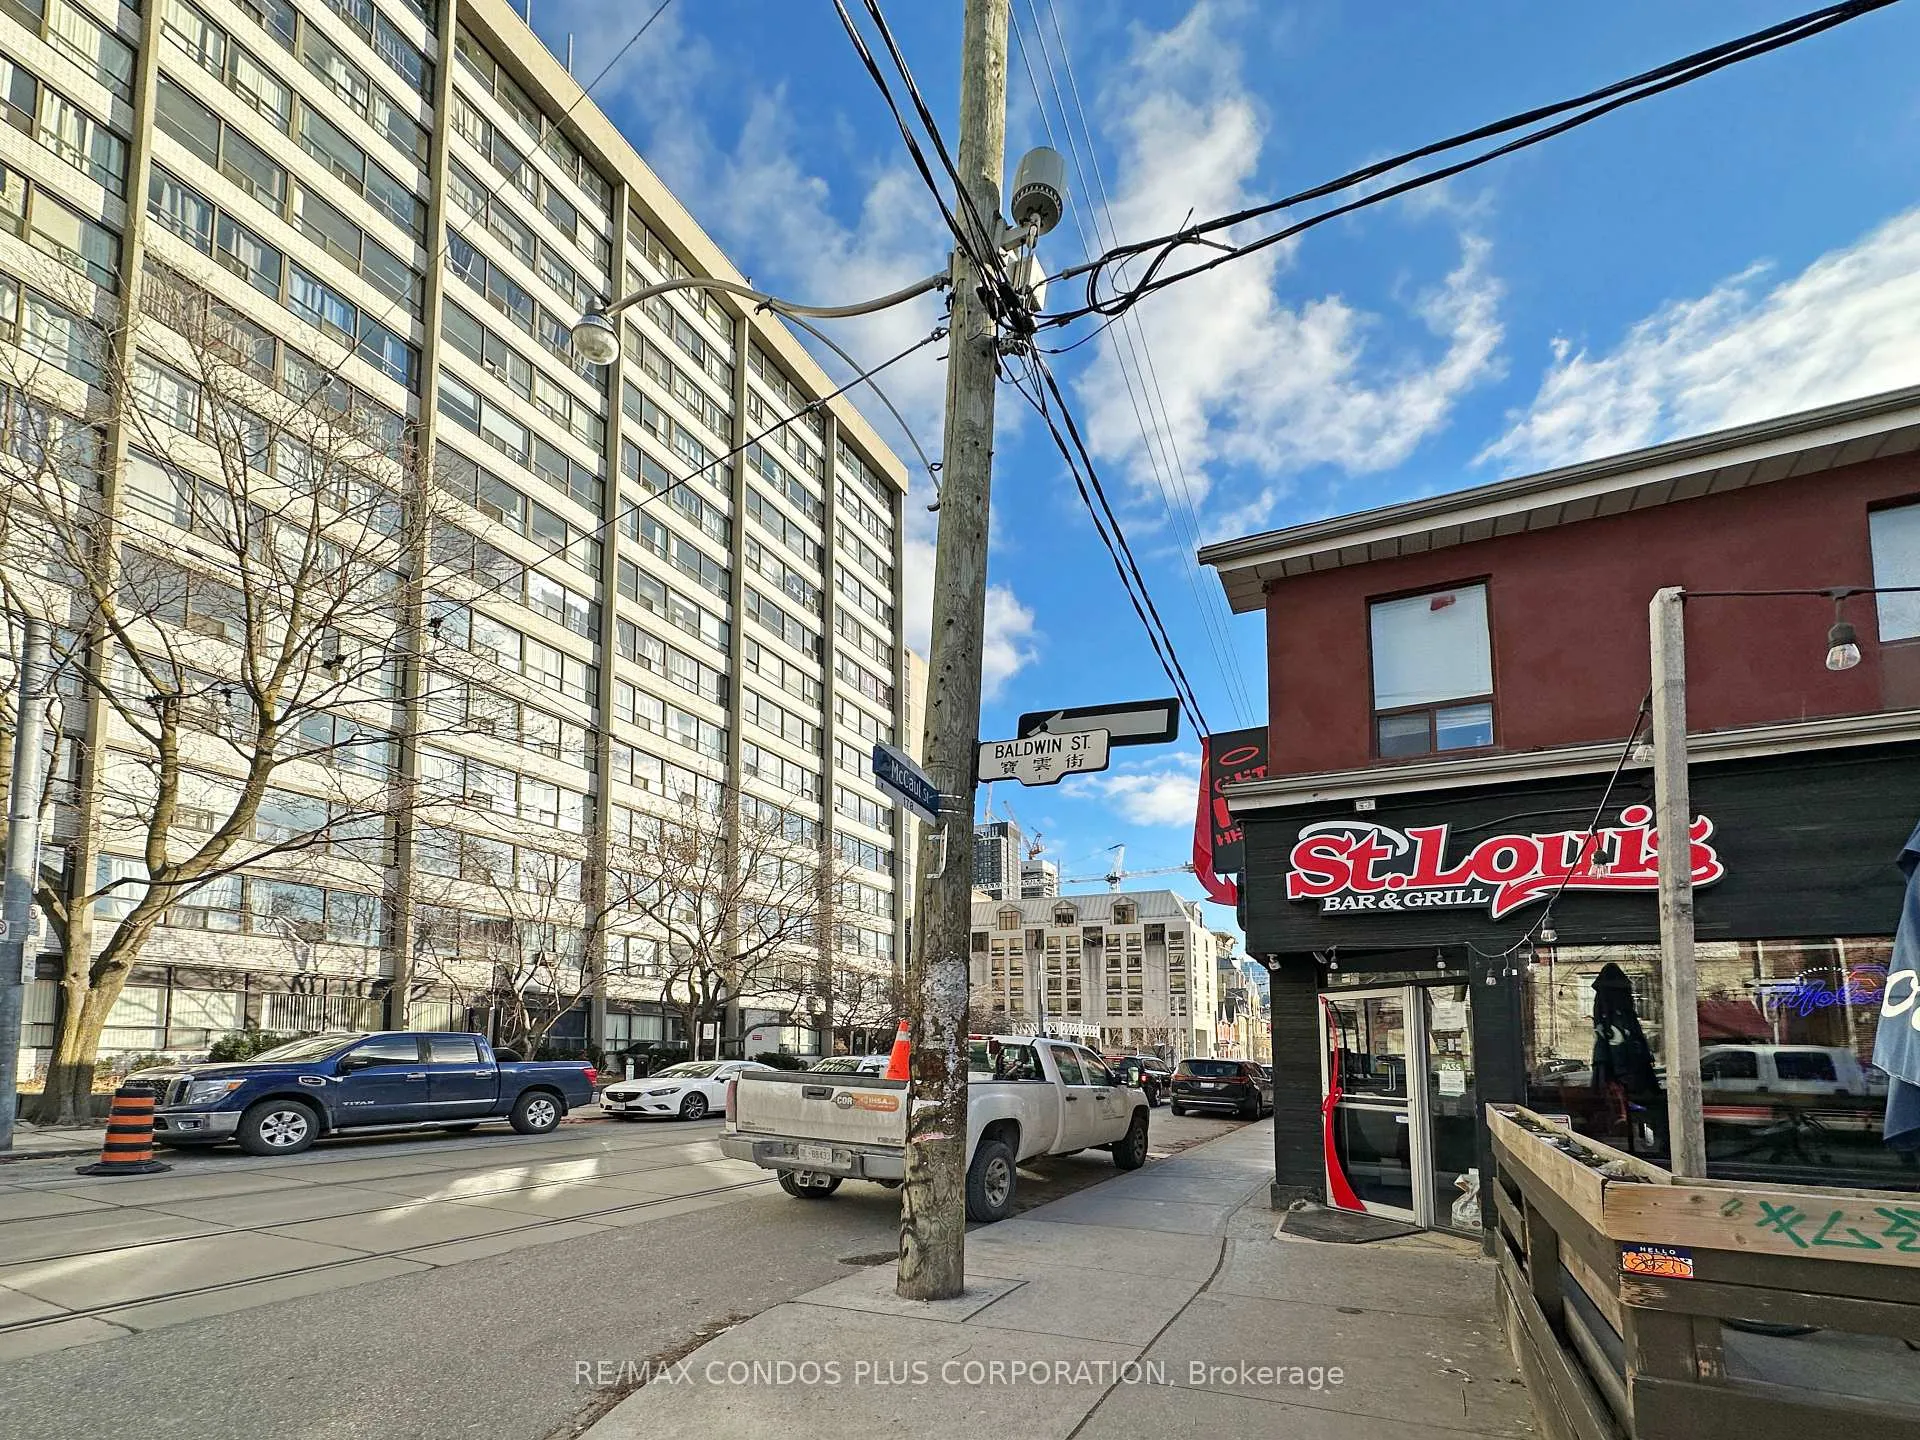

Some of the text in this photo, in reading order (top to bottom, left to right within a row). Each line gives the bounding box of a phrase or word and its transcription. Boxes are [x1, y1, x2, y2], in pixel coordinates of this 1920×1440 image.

[995, 738, 1062, 759] BALDWIN
[891, 760, 922, 799] McCaul
[1441, 1063, 1461, 1071] PASS
[1639, 1246, 1676, 1255] HELLO
